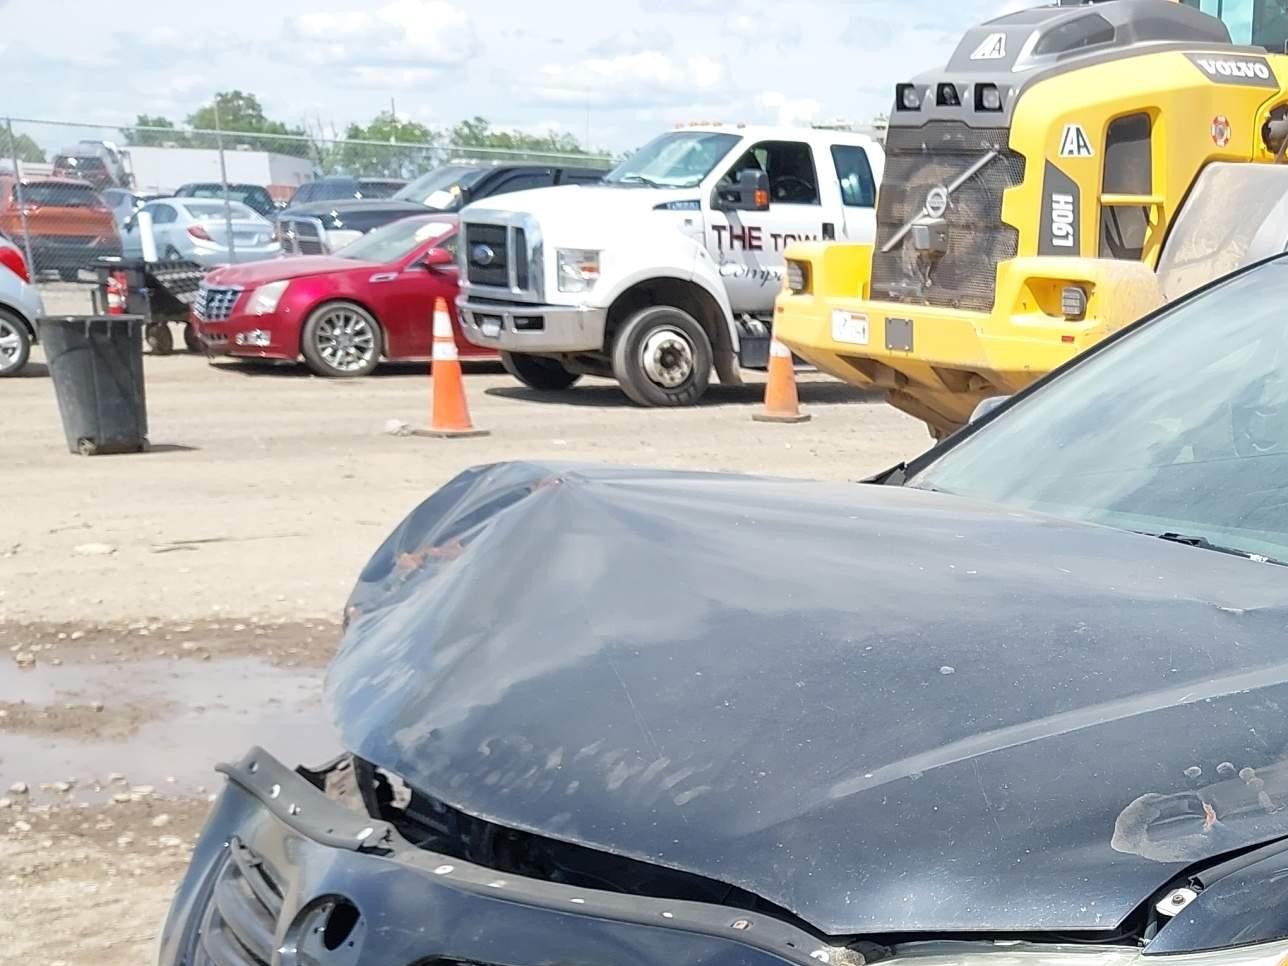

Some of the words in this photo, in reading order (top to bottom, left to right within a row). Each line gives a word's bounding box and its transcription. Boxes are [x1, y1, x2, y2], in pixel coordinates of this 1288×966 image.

[1196, 58, 1270, 79] VOLVO
[1052, 192, 1074, 247] L90H
[711, 224, 763, 251] THE
